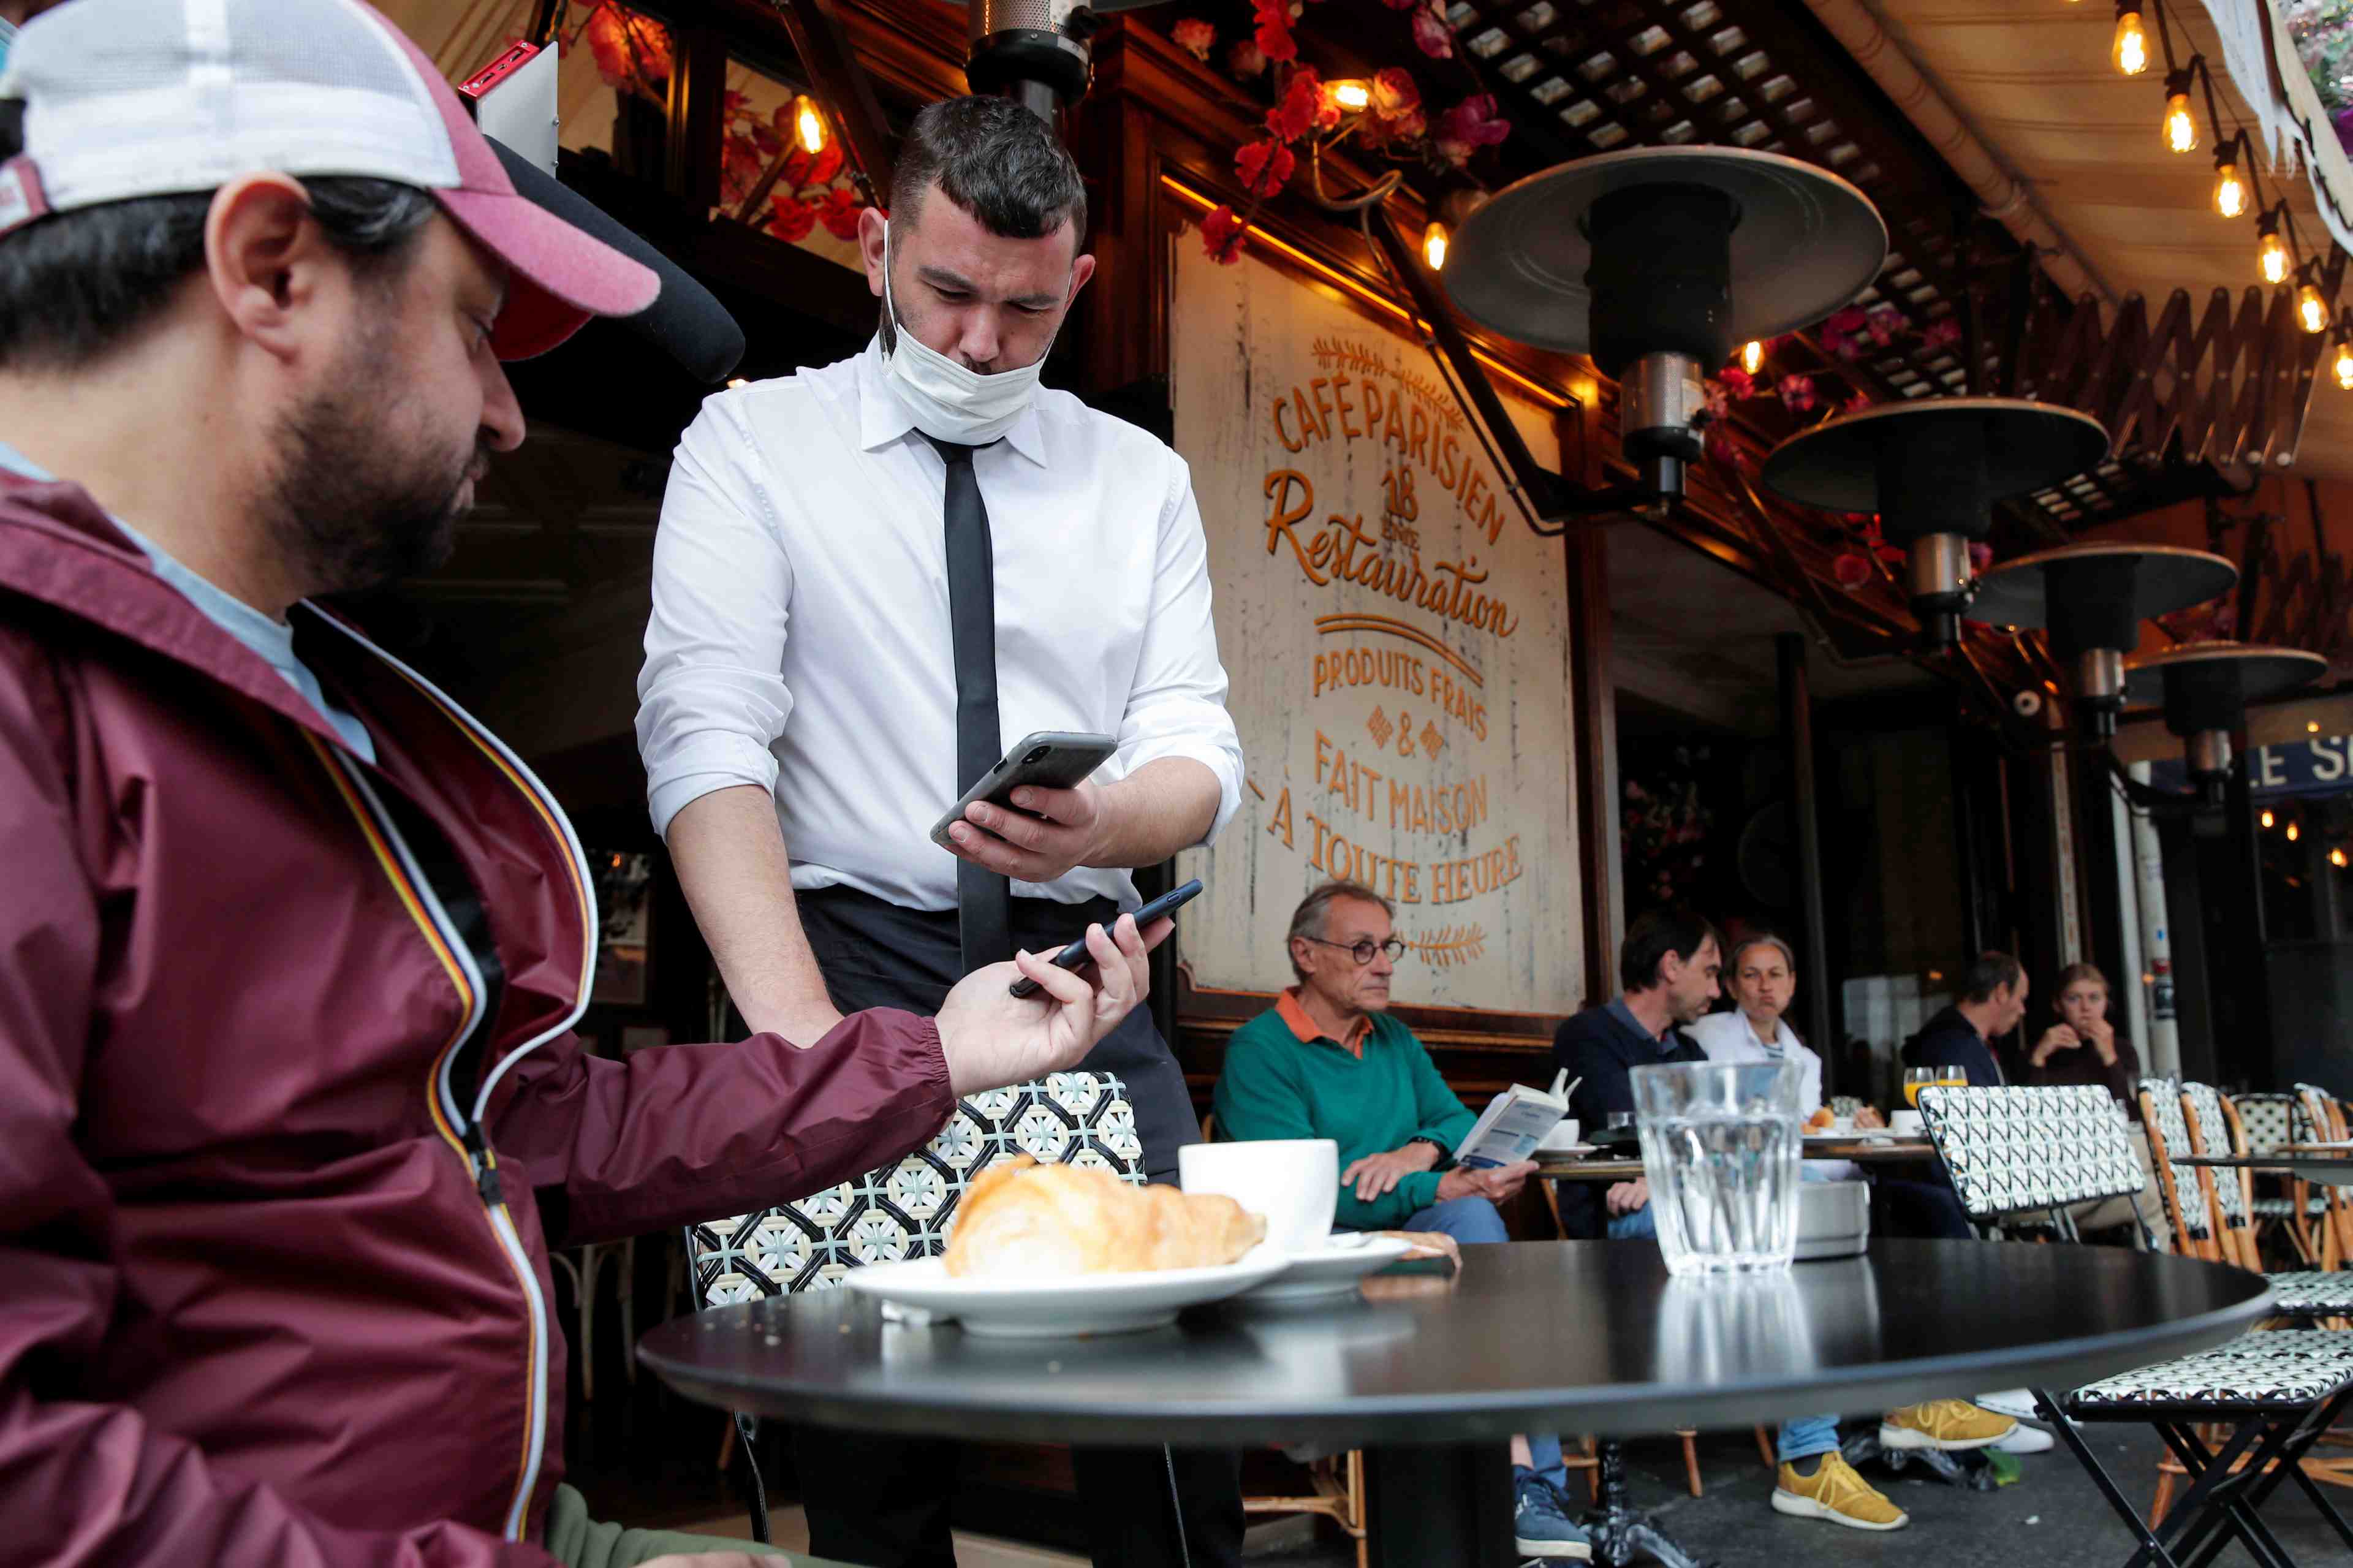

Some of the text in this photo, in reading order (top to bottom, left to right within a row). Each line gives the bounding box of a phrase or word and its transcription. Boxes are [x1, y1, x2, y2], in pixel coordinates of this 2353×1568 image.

[1362, 380, 1506, 544] PARISIEN
[1381, 464, 1419, 522] 18
[1264, 470, 1519, 638] Restauration
[1313, 647, 1487, 742] PRODUITS FRAIS
[1398, 711, 1417, 758] &
[1315, 729, 1488, 835] FAIT MAISON
[2309, 735, 2353, 782] S
[1306, 810, 1422, 904] TOUTE
[1430, 833, 1523, 906] HEURE
